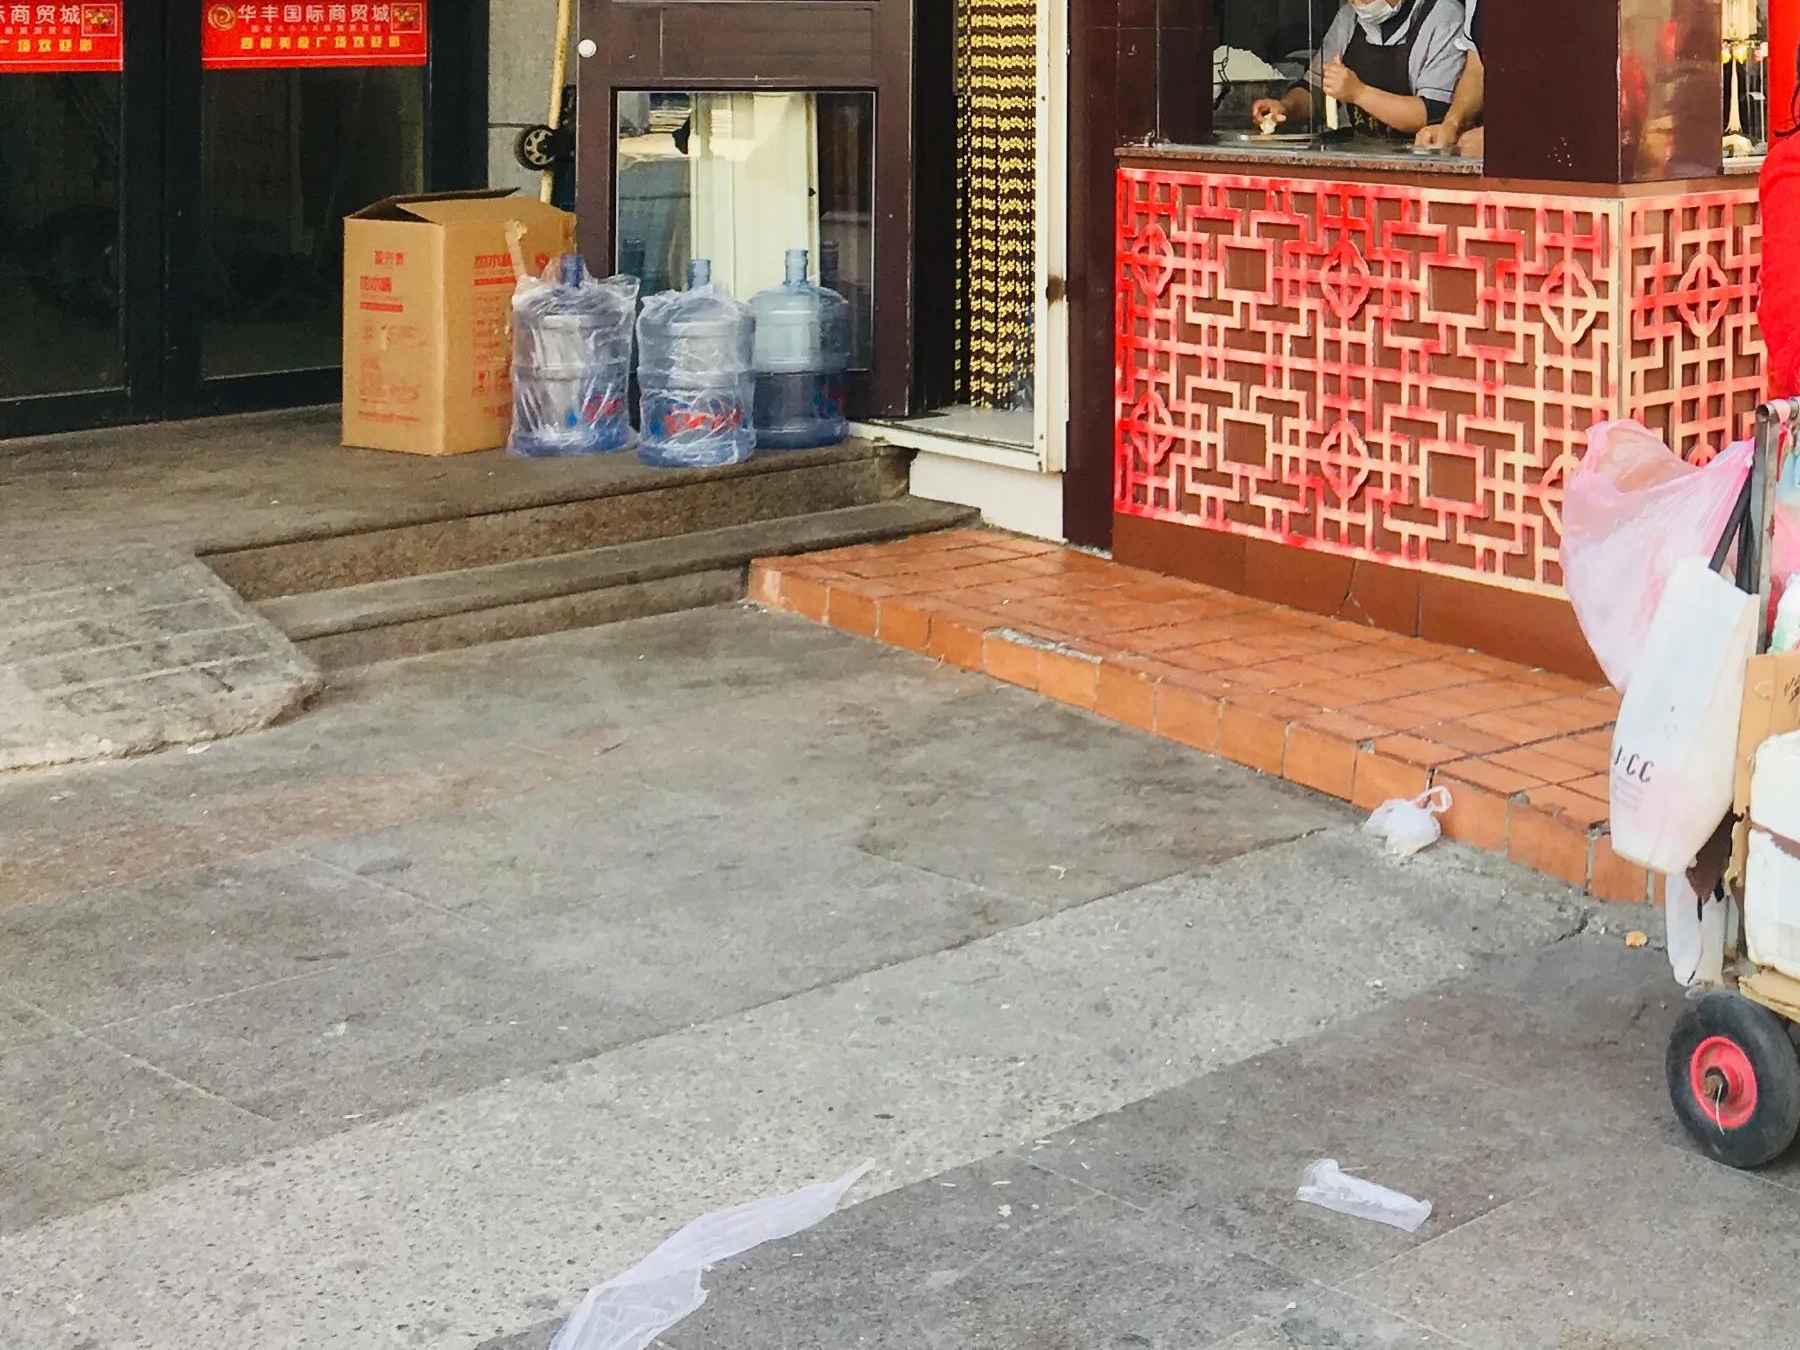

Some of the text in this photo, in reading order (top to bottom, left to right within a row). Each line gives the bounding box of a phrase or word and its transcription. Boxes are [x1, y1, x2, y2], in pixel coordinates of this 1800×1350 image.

[238, 3, 390, 24] 华丰国际商贸城
